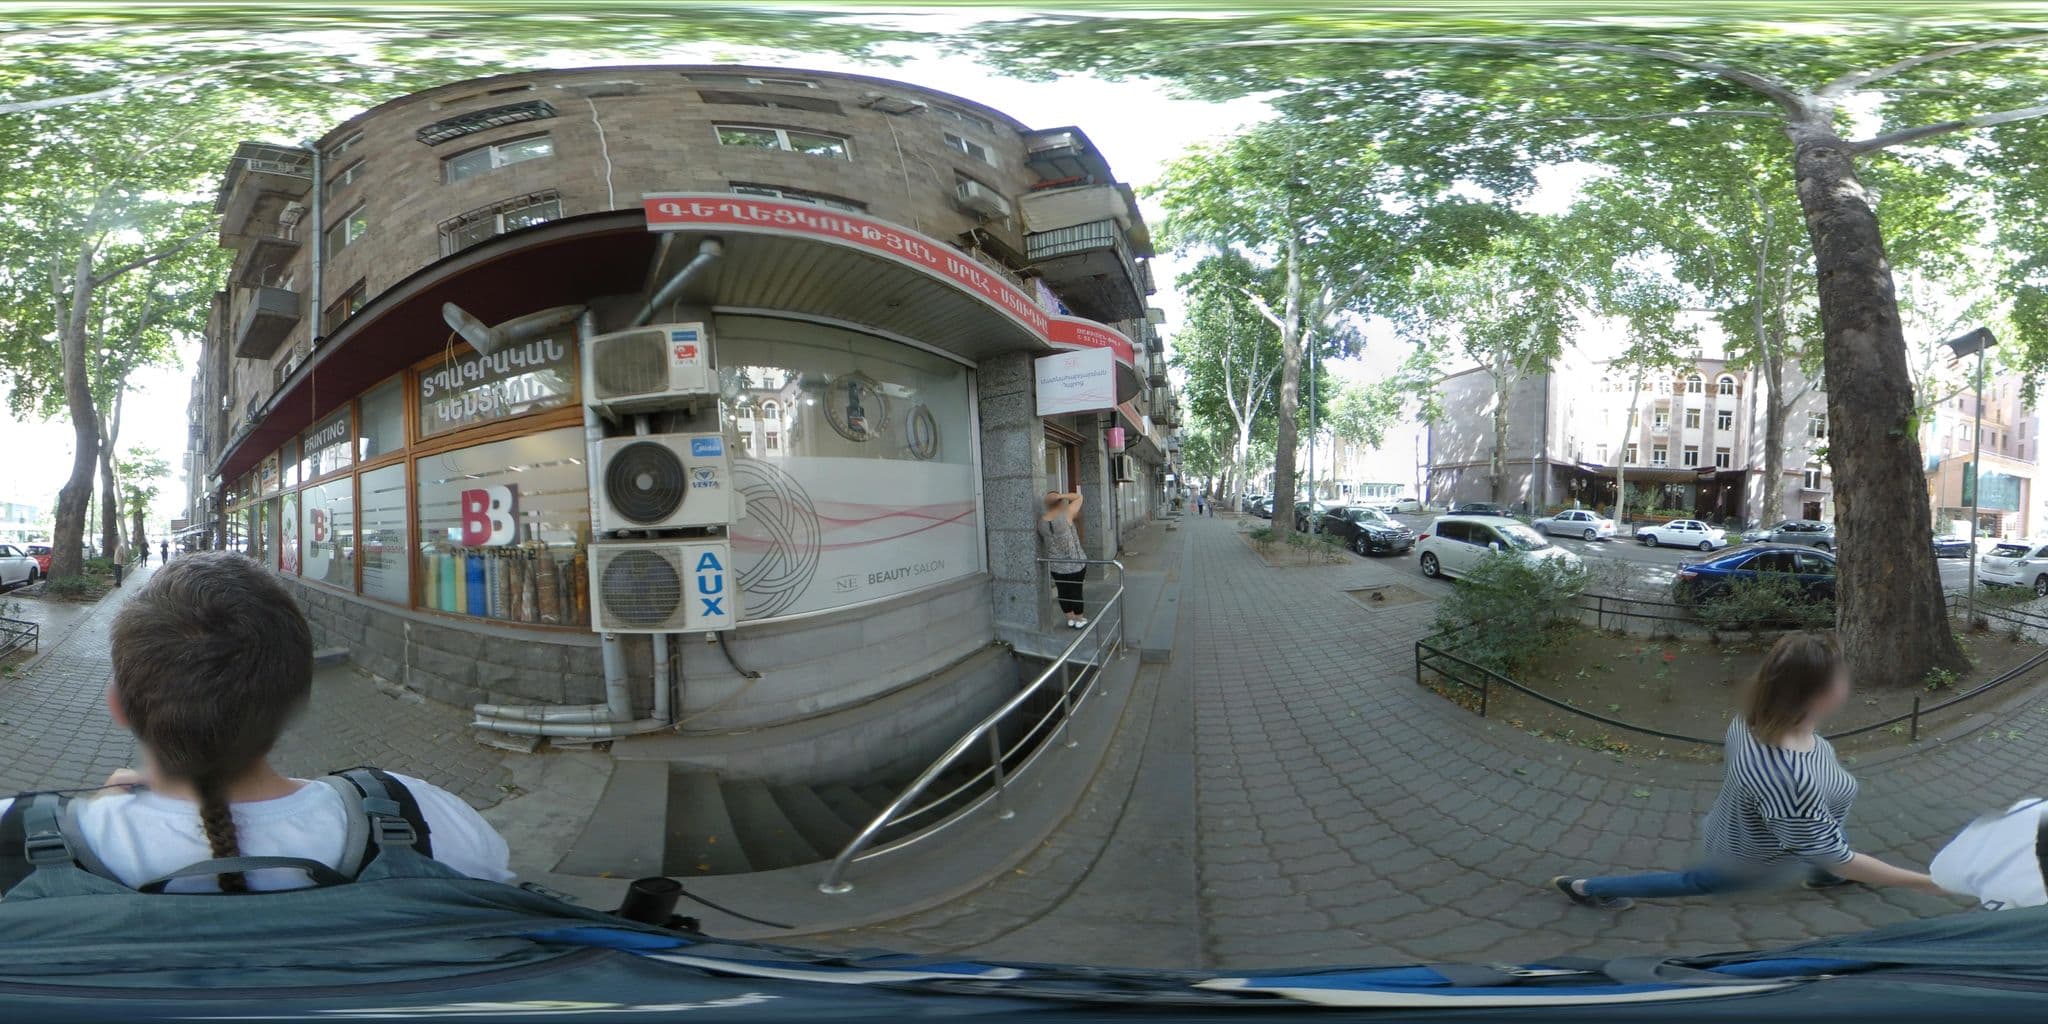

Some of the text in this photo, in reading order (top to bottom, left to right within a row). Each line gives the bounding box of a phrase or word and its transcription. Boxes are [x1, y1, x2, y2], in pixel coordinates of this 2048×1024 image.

[658, 202, 937, 264] ԳԵՂԵՑԿՈՒԹՅԱՆ
[947, 257, 990, 294] ՍՐԱՀ
[423, 338, 565, 398] ՏՊԱԳՐԱԿԱՆ
[436, 376, 544, 422] ԿԵՆՏՐՈՆ
[304, 419, 345, 455] PRINTING
[692, 480, 720, 489] VESTA
[695, 552, 725, 617] AUX
[867, 566, 912, 585] BEAUTY
[913, 559, 946, 576] SALON
